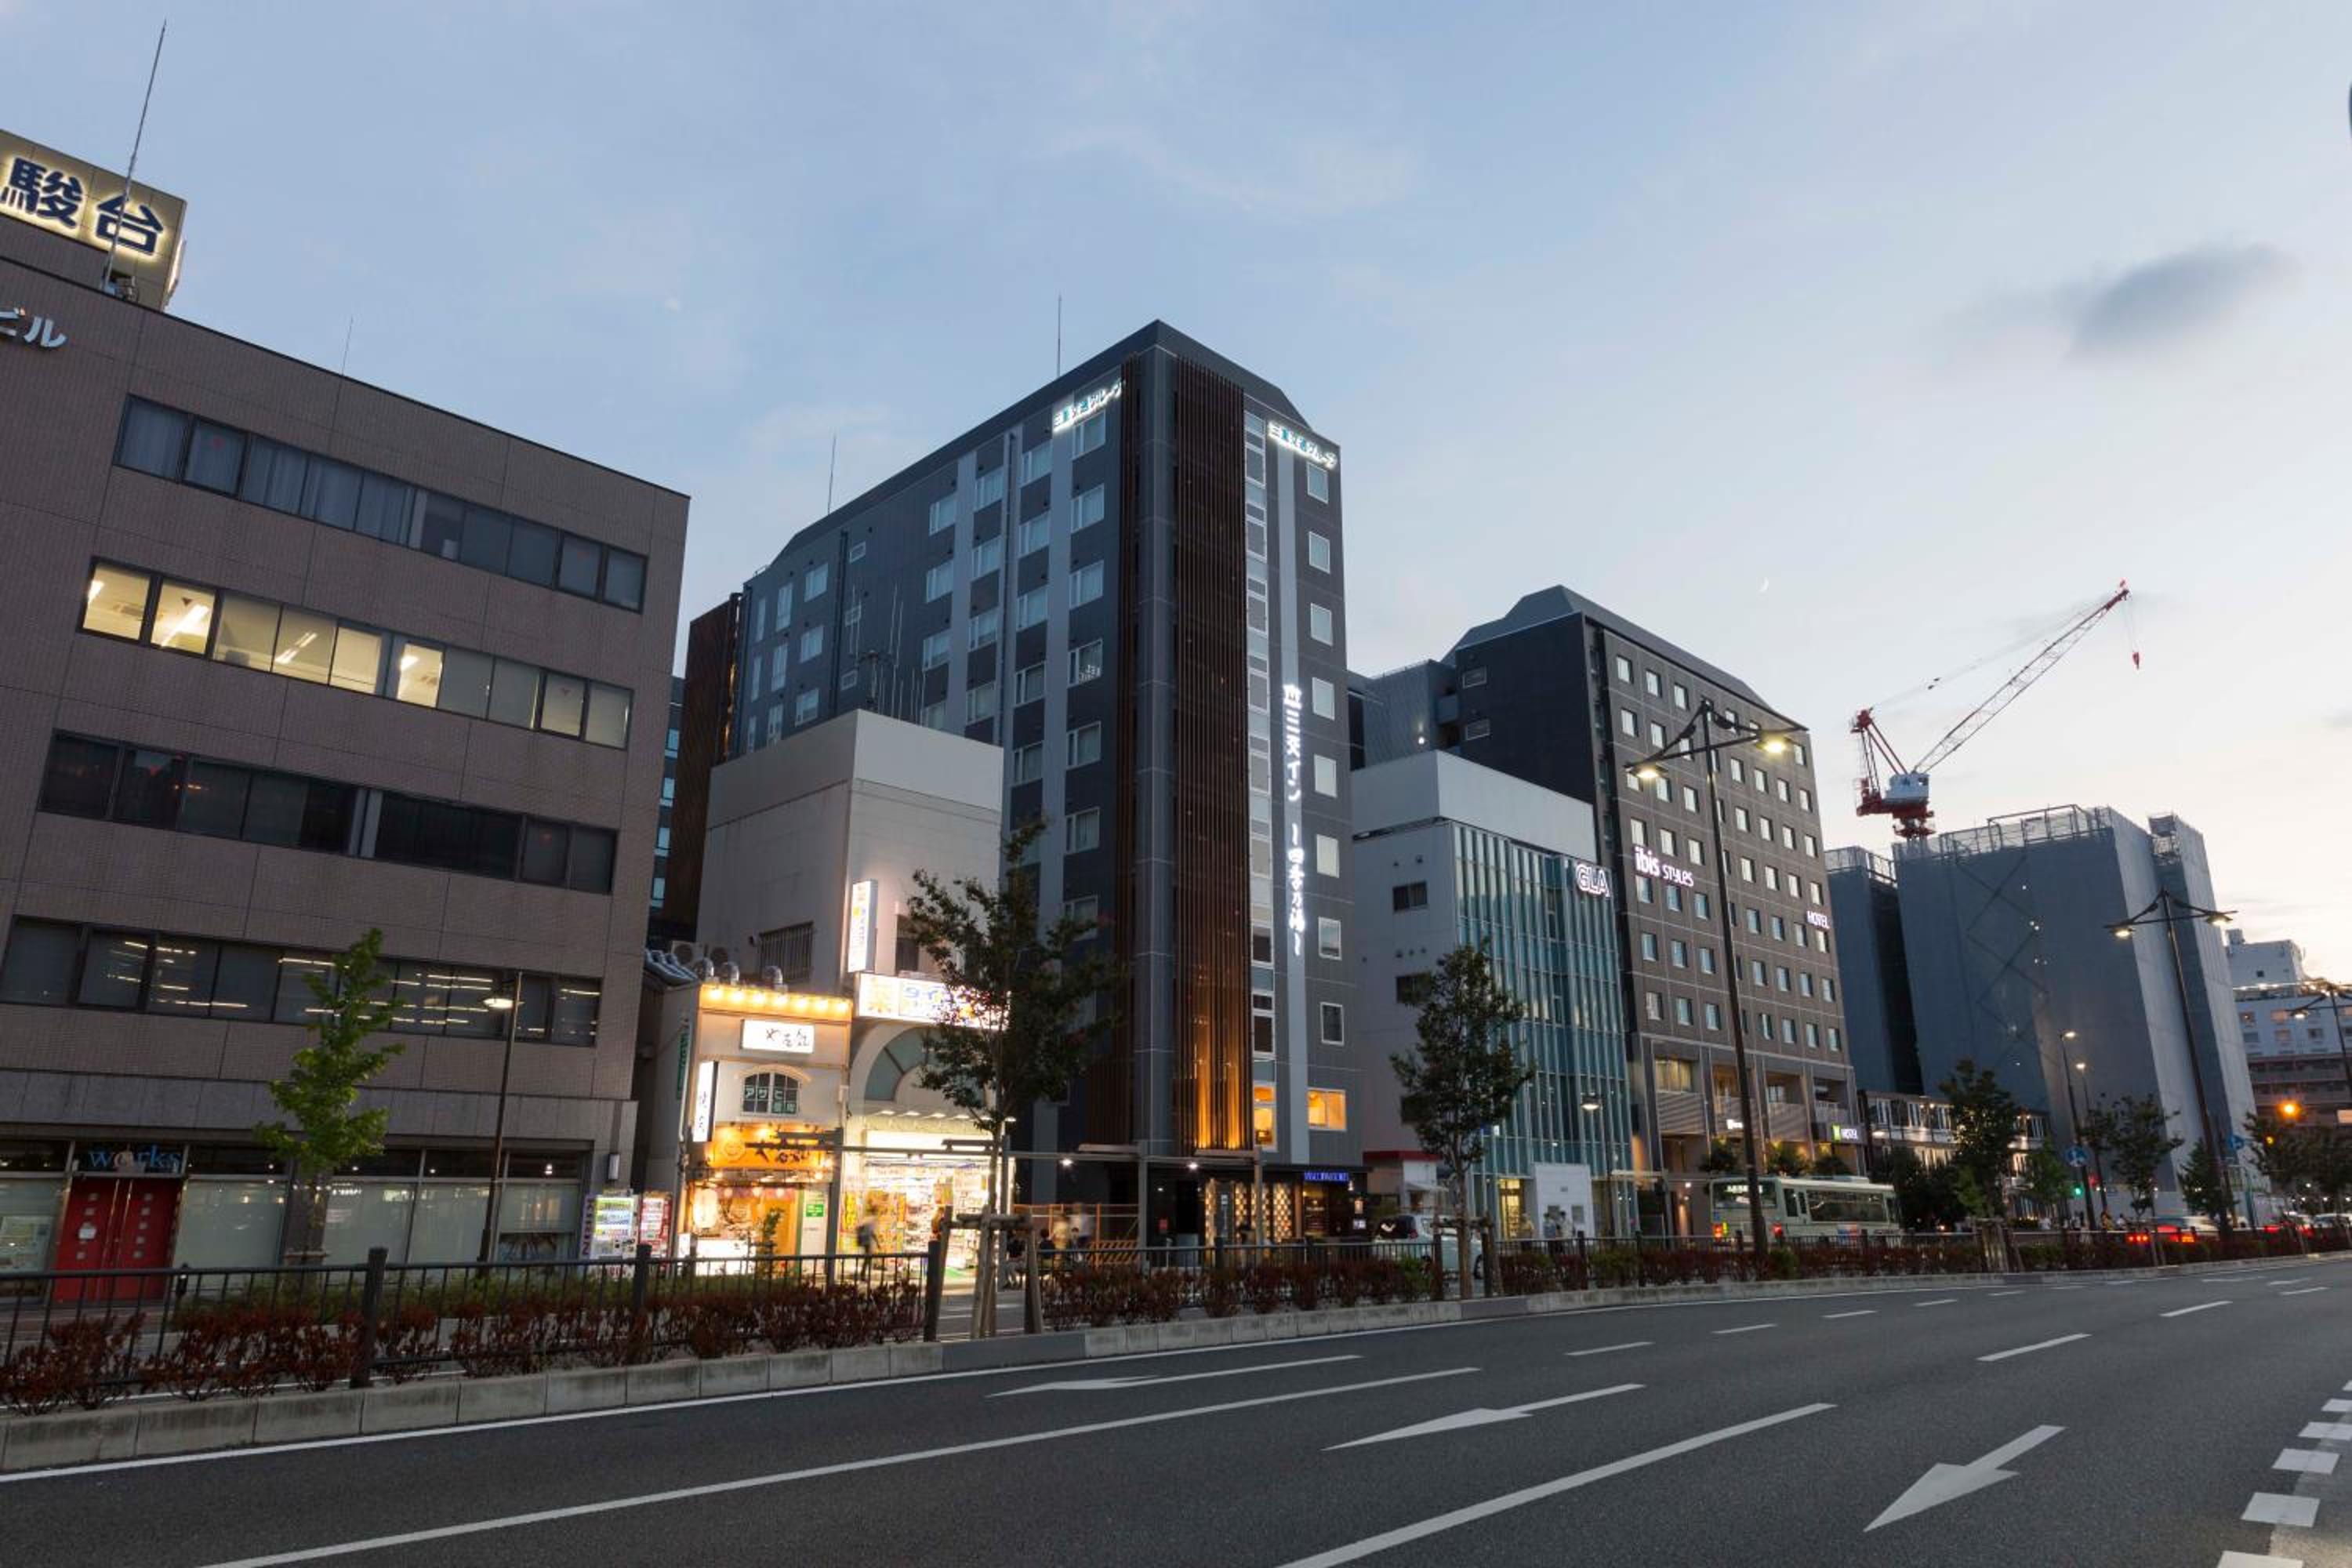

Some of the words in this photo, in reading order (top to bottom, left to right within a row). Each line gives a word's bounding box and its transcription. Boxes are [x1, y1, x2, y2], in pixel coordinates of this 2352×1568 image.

[1, 158, 164, 256] 駿台
[1635, 846, 1661, 876] ibis
[1806, 910, 1830, 929] HOTEL
